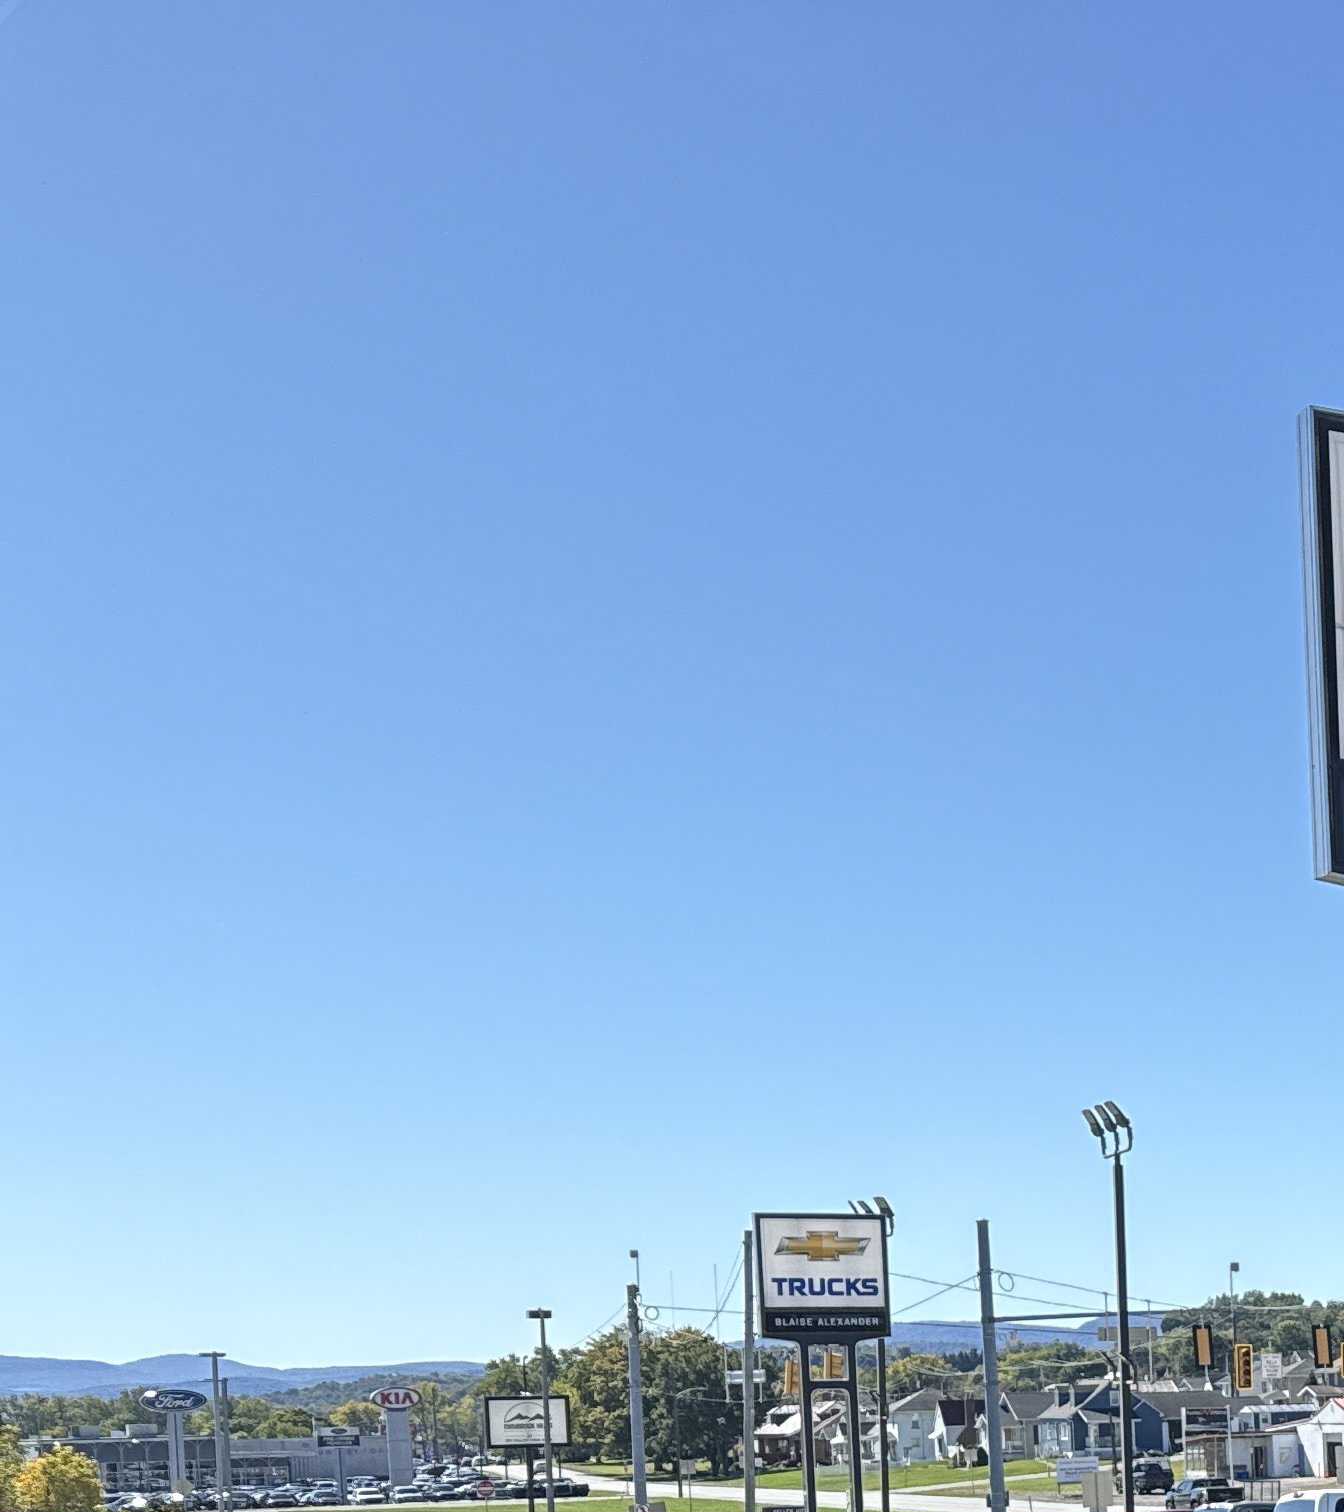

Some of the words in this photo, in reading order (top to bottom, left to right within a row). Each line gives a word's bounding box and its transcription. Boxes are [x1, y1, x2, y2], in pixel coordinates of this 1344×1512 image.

[771, 1277, 880, 1297] TRUCKS
[775, 1316, 813, 1327] BLAISE
[817, 1316, 880, 1327] ALEXANDER
[154, 1393, 194, 1408] Ford
[380, 1391, 415, 1405] KIA
